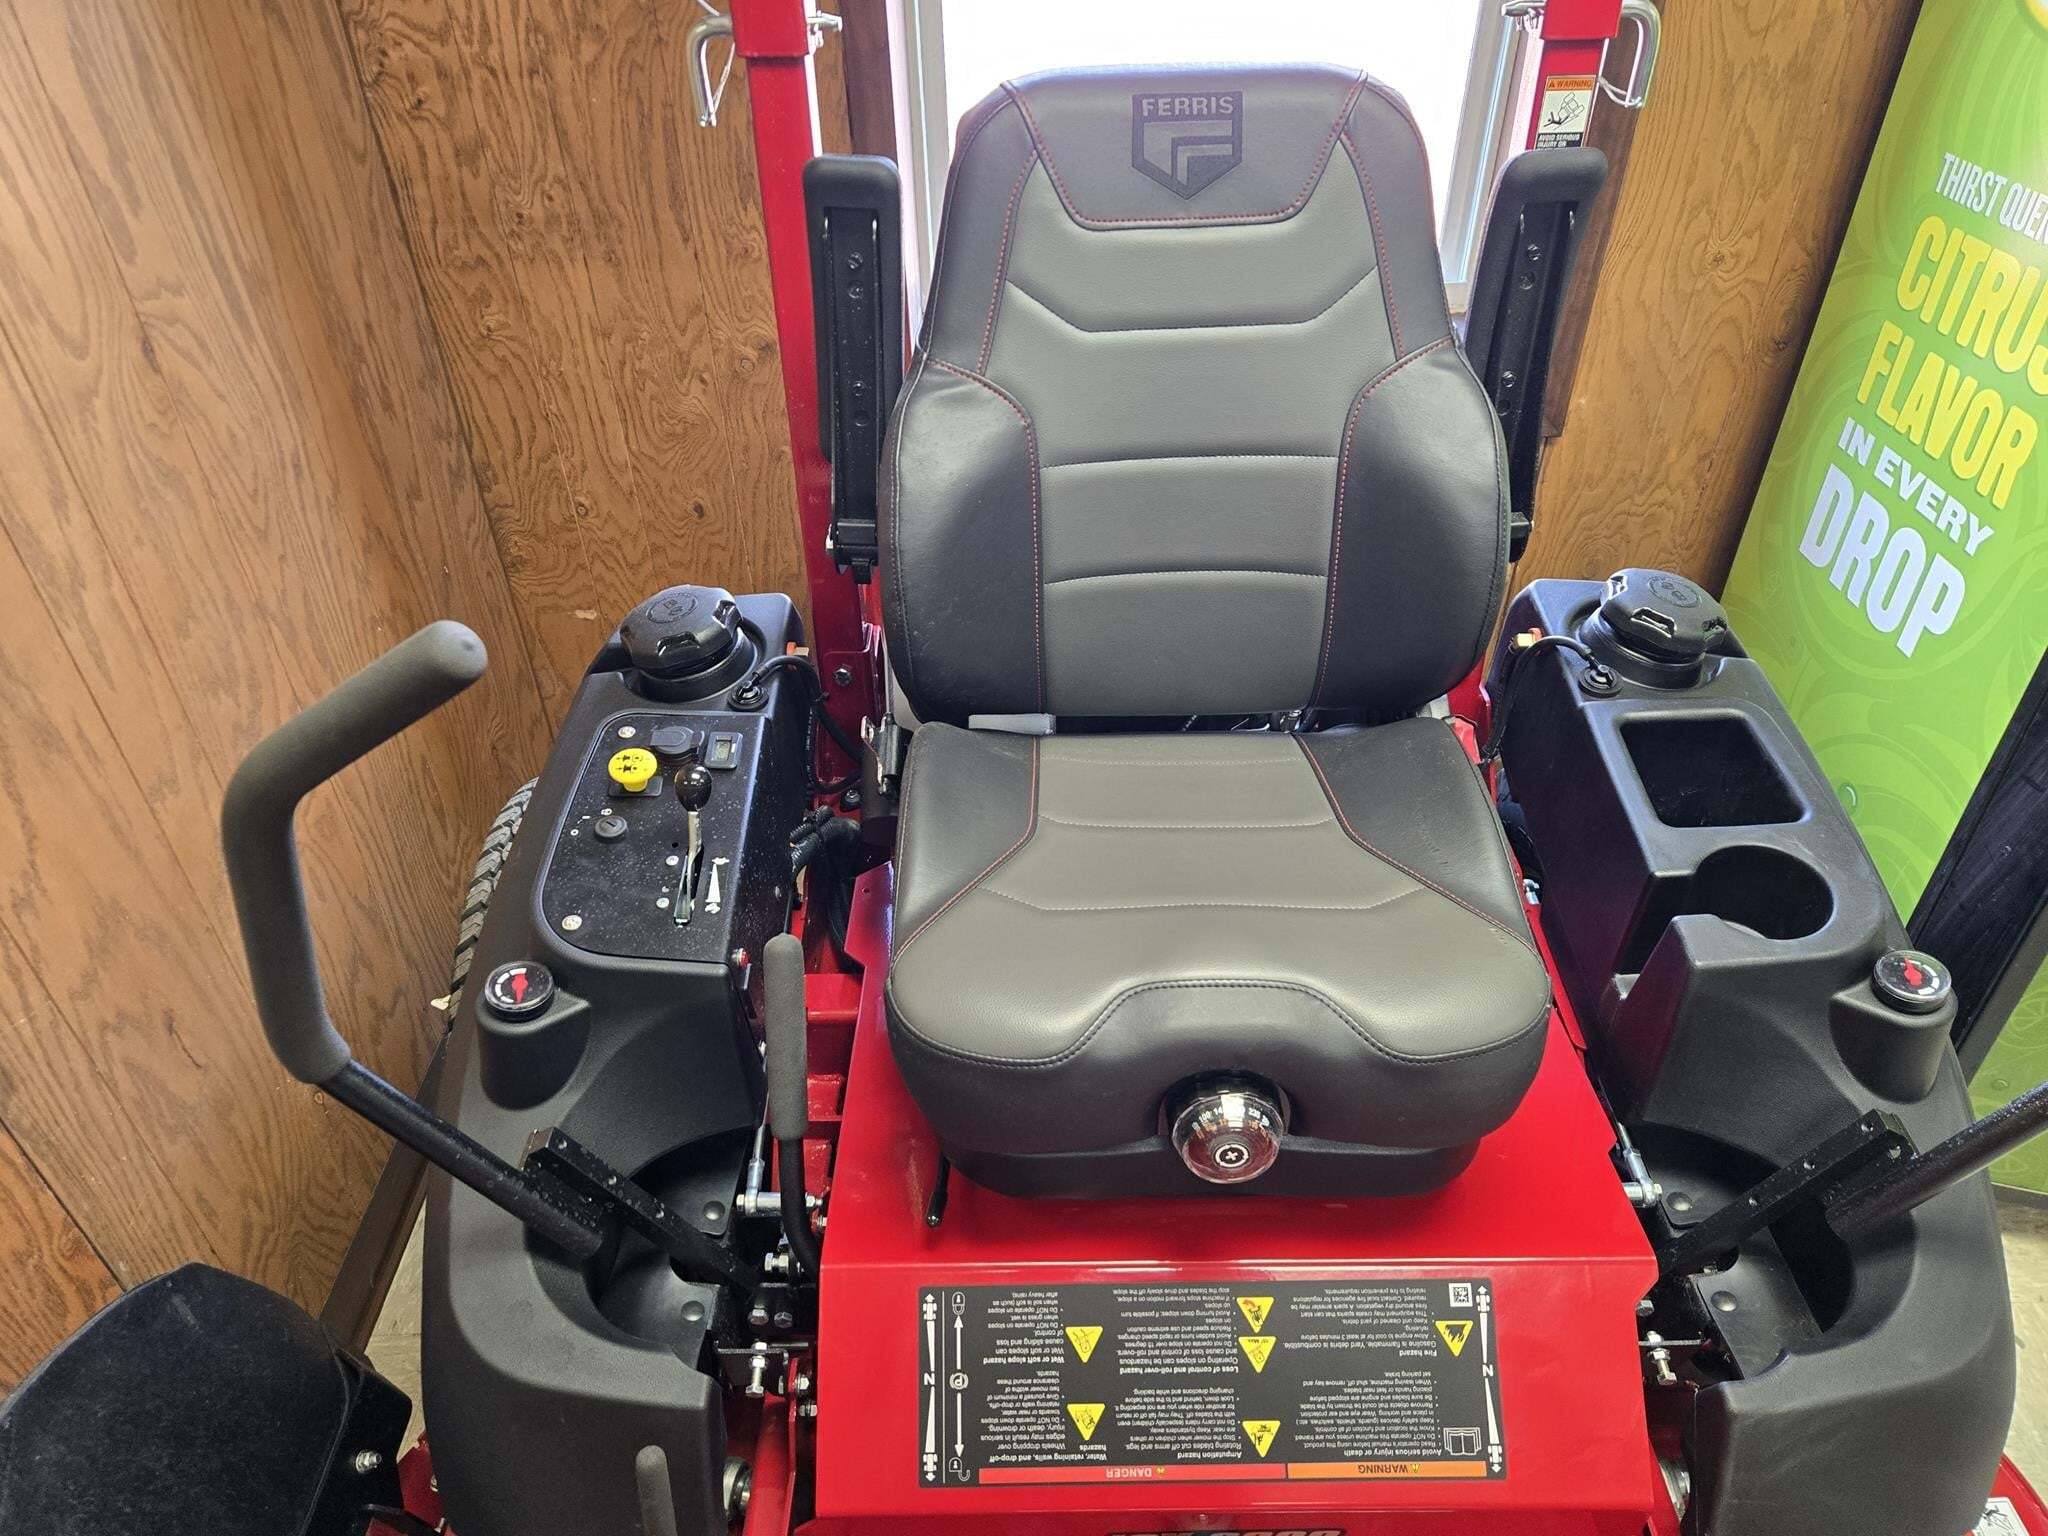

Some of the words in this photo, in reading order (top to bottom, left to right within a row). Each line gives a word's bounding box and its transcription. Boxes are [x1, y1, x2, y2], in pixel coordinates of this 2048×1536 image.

[1557, 79, 1592, 88] WARNING
[1142, 96, 1234, 116] FERRIS
[1935, 152, 2008, 217] THIRST
[1856, 319, 2039, 511] FLAVOR
[1837, 416, 1877, 466] IN
[1873, 445, 1996, 557] EVERY
[1798, 463, 1967, 659] DROP
[1024, 1337, 1044, 1345] sliding
[1007, 1356, 1026, 1364] slope
[1176, 1356, 1197, 1364] slopes
[1207, 1356, 1238, 1364] Operating
[1482, 1364, 1493, 1376] N
[924, 1372, 935, 1385] N
[1046, 1433, 1065, 1441] edges
[1013, 1442, 1041, 1450] dropping
[1215, 1442, 1241, 1450] Rotating
[1202, 1451, 1241, 1459] Amputation
[1373, 1448, 1394, 1456] injury
[1054, 1453, 1084, 1461] retaining
[1358, 1464, 1408, 1473] WARNING
[1106, 1468, 1152, 1478] DANGER
